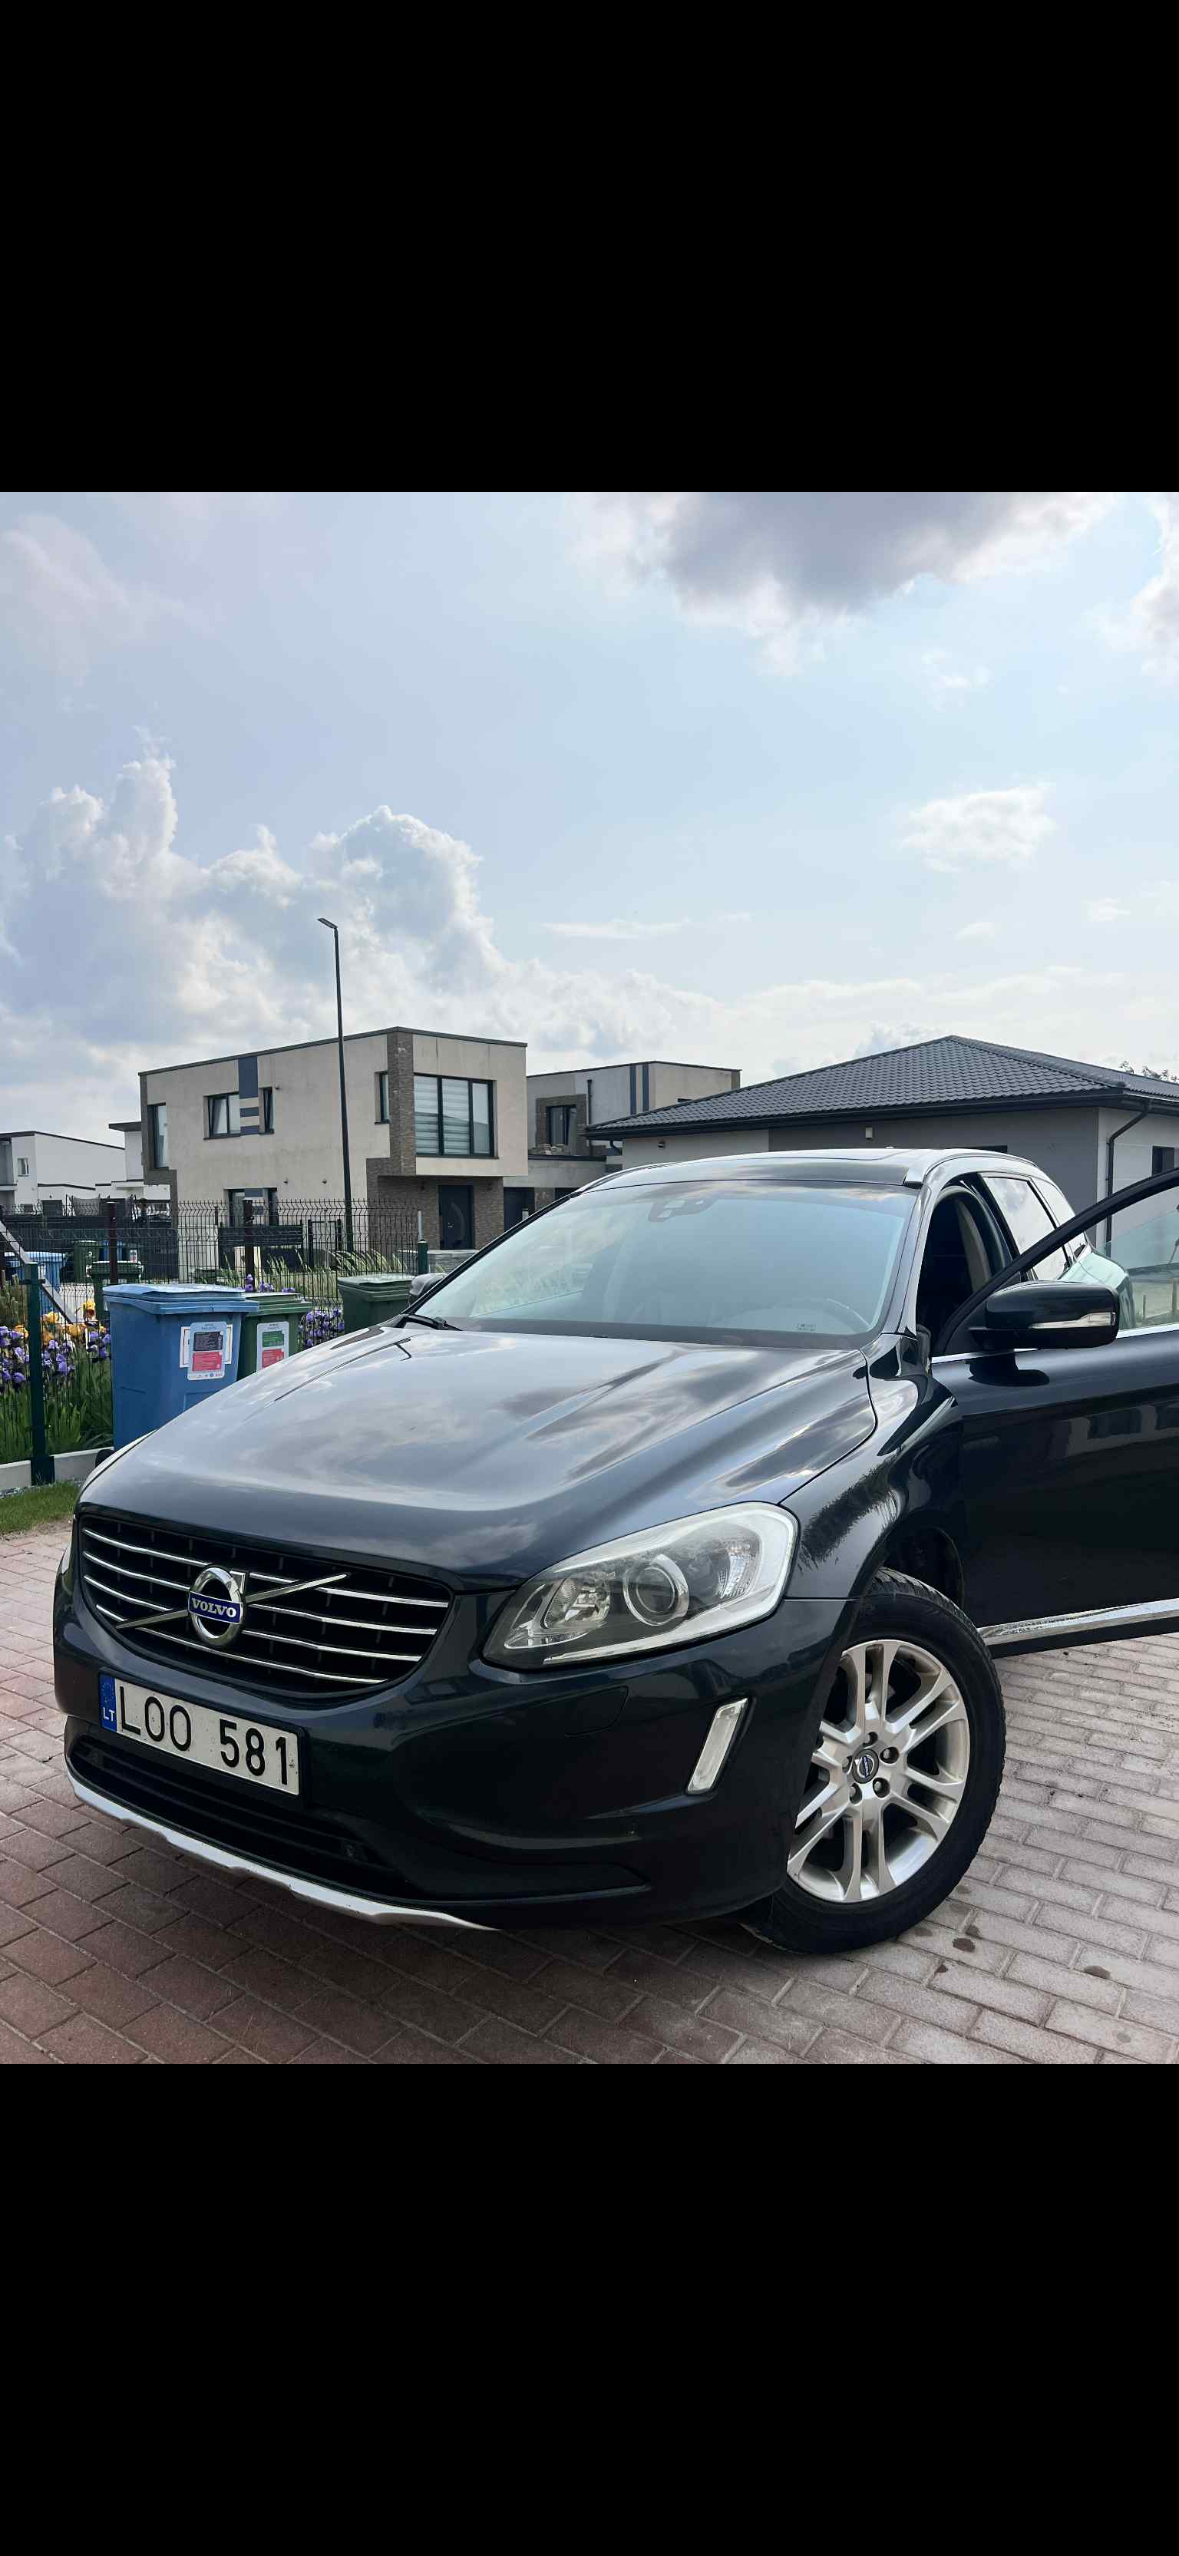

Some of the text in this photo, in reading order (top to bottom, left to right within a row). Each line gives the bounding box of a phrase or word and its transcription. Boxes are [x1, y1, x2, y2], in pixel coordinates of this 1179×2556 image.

[191, 1597, 237, 1618] VOLVO
[103, 1707, 115, 1722] LT
[120, 1686, 288, 1785] LOO 581
